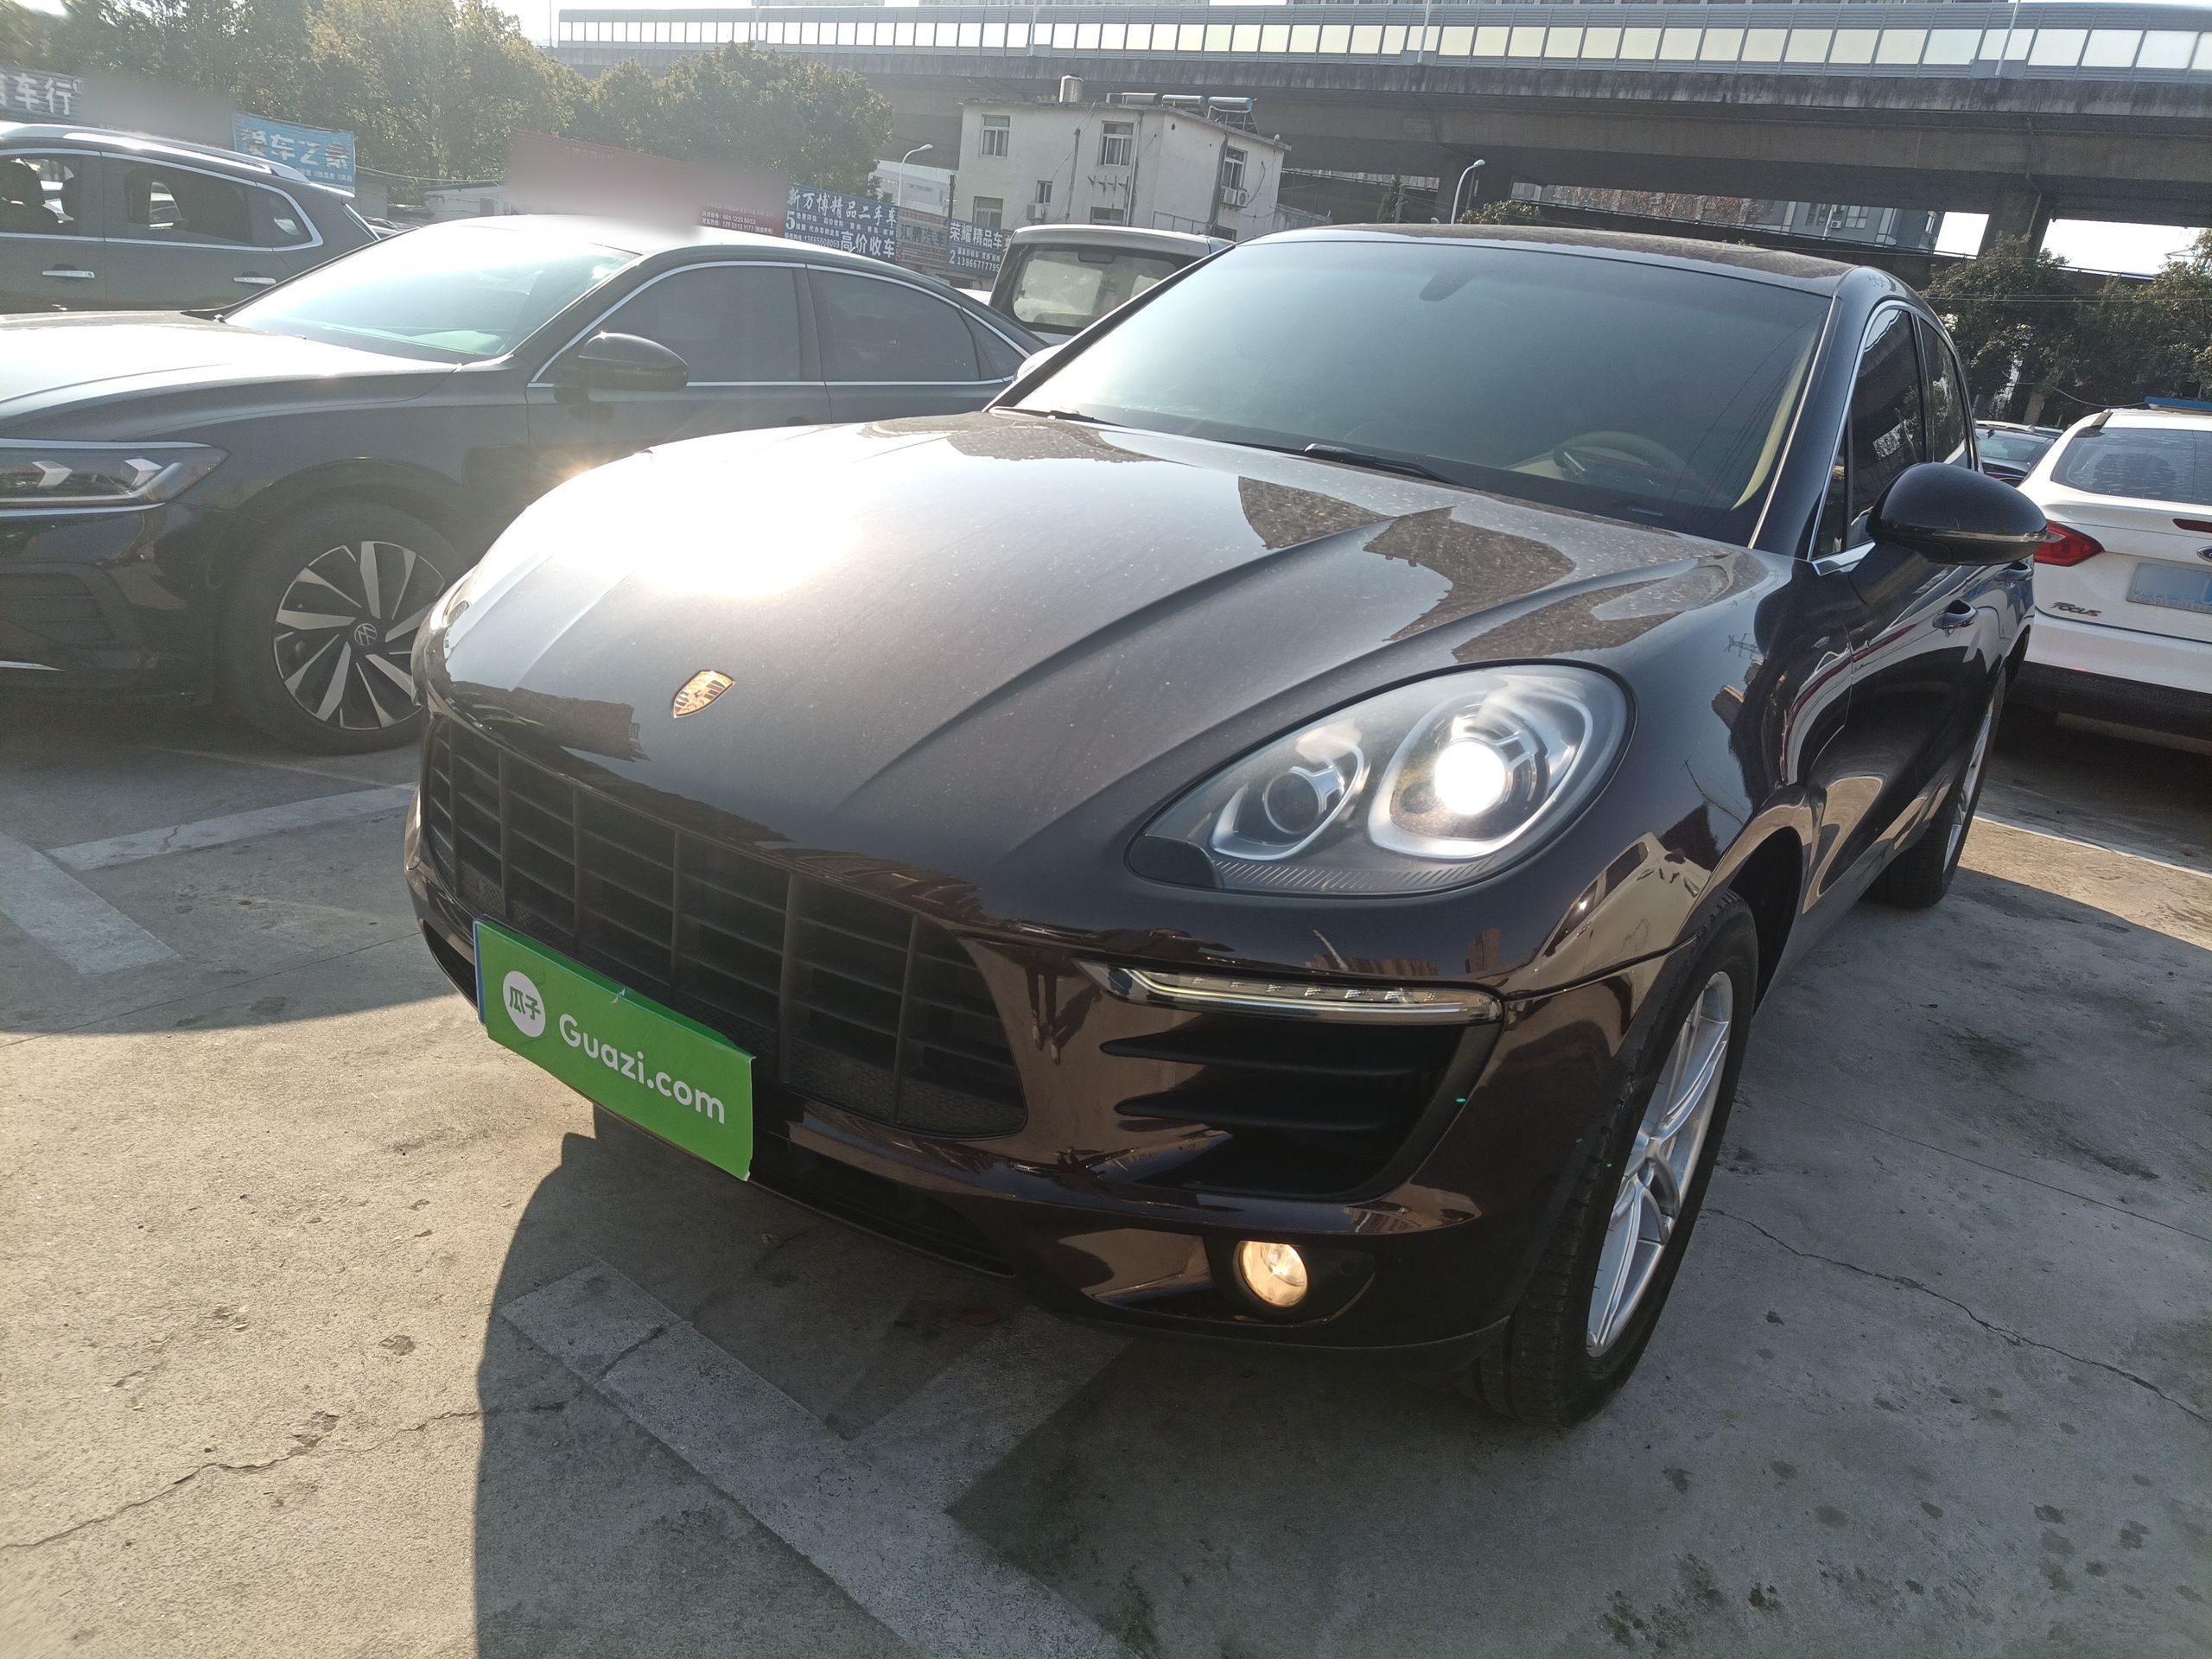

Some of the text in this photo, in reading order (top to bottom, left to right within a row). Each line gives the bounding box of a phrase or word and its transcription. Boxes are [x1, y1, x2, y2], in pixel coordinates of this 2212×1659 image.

[785, 210, 796, 230] 5
[786, 186, 897, 229] 新万博精品二手车
[841, 231, 895, 258] 高价收车
[950, 222, 1003, 249] 荣耀精品车
[509, 985, 541, 1021] 瓜子
[559, 1014, 725, 1125] Guazi.com
